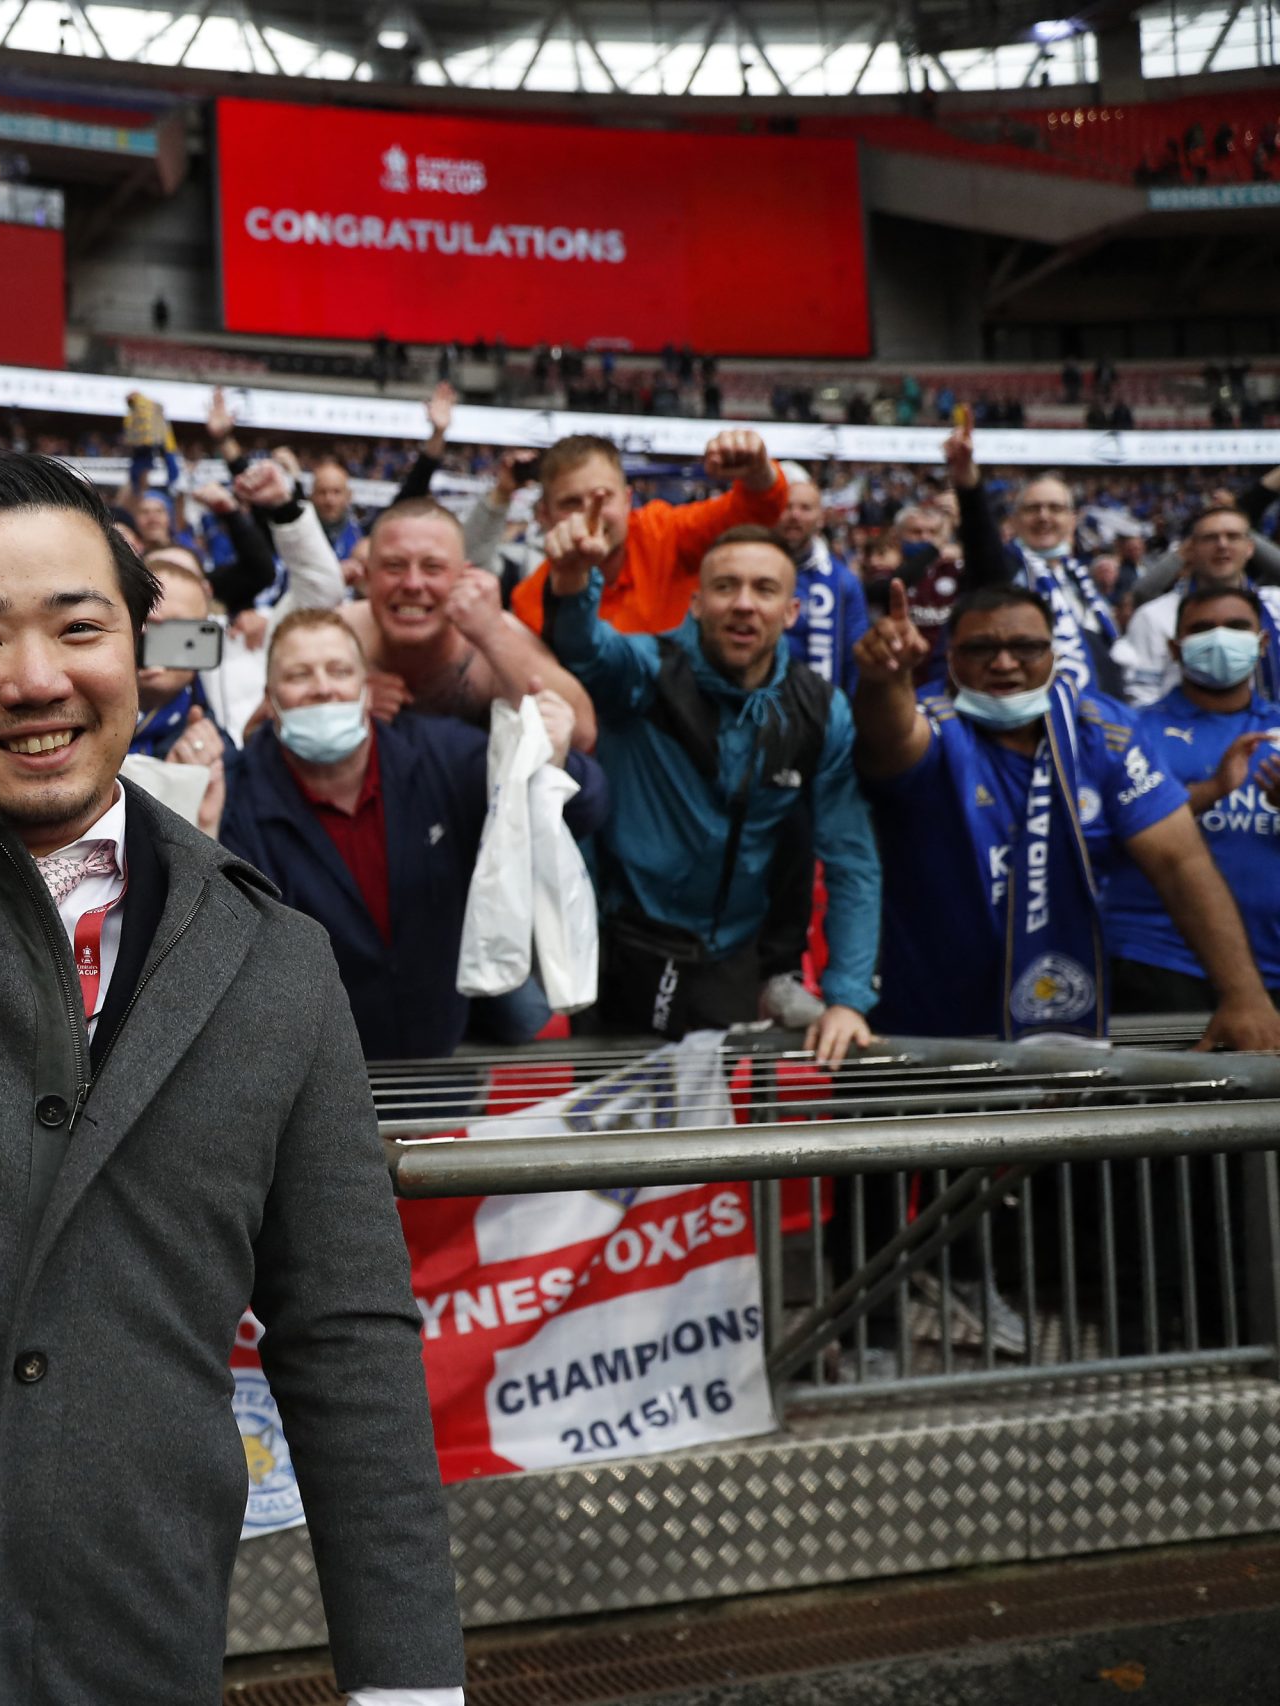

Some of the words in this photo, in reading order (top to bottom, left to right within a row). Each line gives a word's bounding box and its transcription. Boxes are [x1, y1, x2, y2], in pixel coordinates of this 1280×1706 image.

[244, 206, 627, 264] CONGRATULATIONS
[416, 1266, 574, 1340] YNES
[495, 1305, 762, 1415] CHAMPIONS
[560, 1378, 735, 1453] 2015/16
